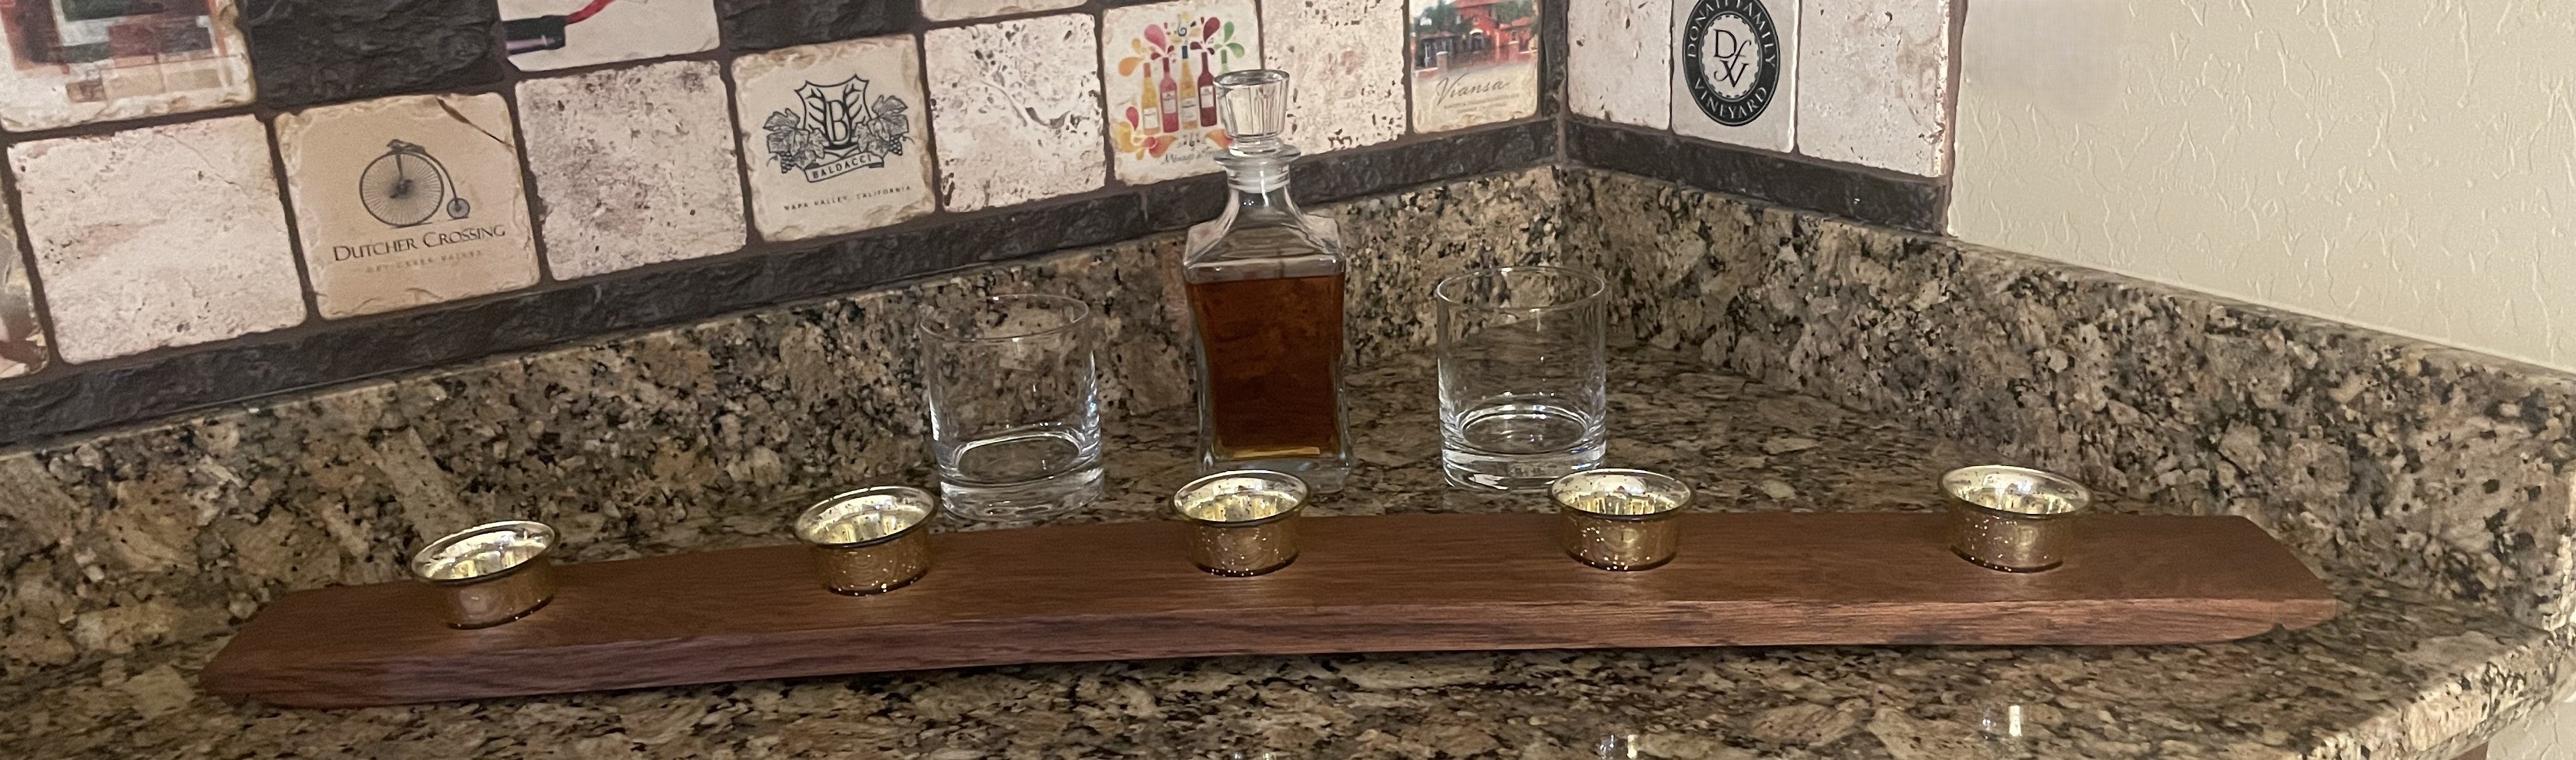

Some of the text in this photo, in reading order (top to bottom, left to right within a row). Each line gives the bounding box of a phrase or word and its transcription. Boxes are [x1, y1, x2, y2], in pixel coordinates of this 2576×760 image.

[1436, 72, 1511, 105] Viansa
[1695, 78, 1767, 119] VINEYARD
[812, 154, 871, 178] BALDACCI
[333, 238, 418, 261] DUTCHER
[422, 225, 506, 248] CROSSING
